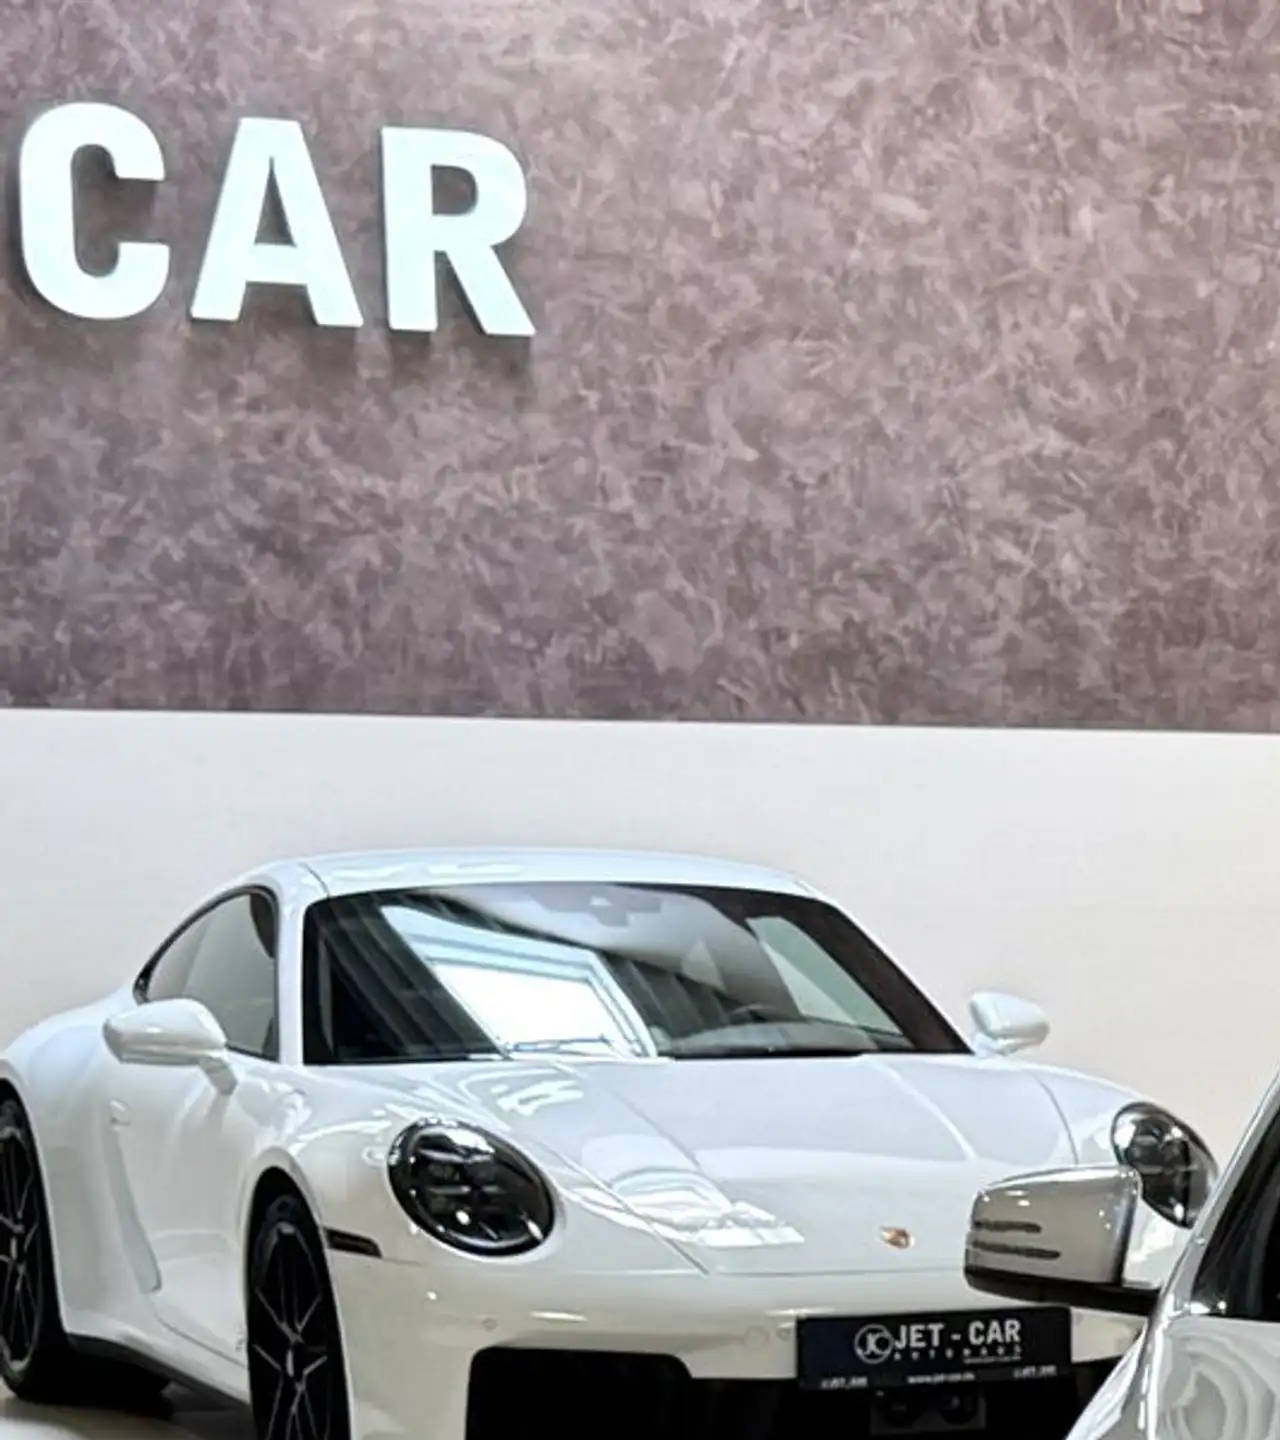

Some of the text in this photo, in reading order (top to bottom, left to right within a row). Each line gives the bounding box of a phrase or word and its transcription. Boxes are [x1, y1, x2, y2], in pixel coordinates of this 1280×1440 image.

[19, 102, 535, 336] CAR
[893, 1323, 945, 1350] JET
[968, 1318, 1021, 1346] CAR
